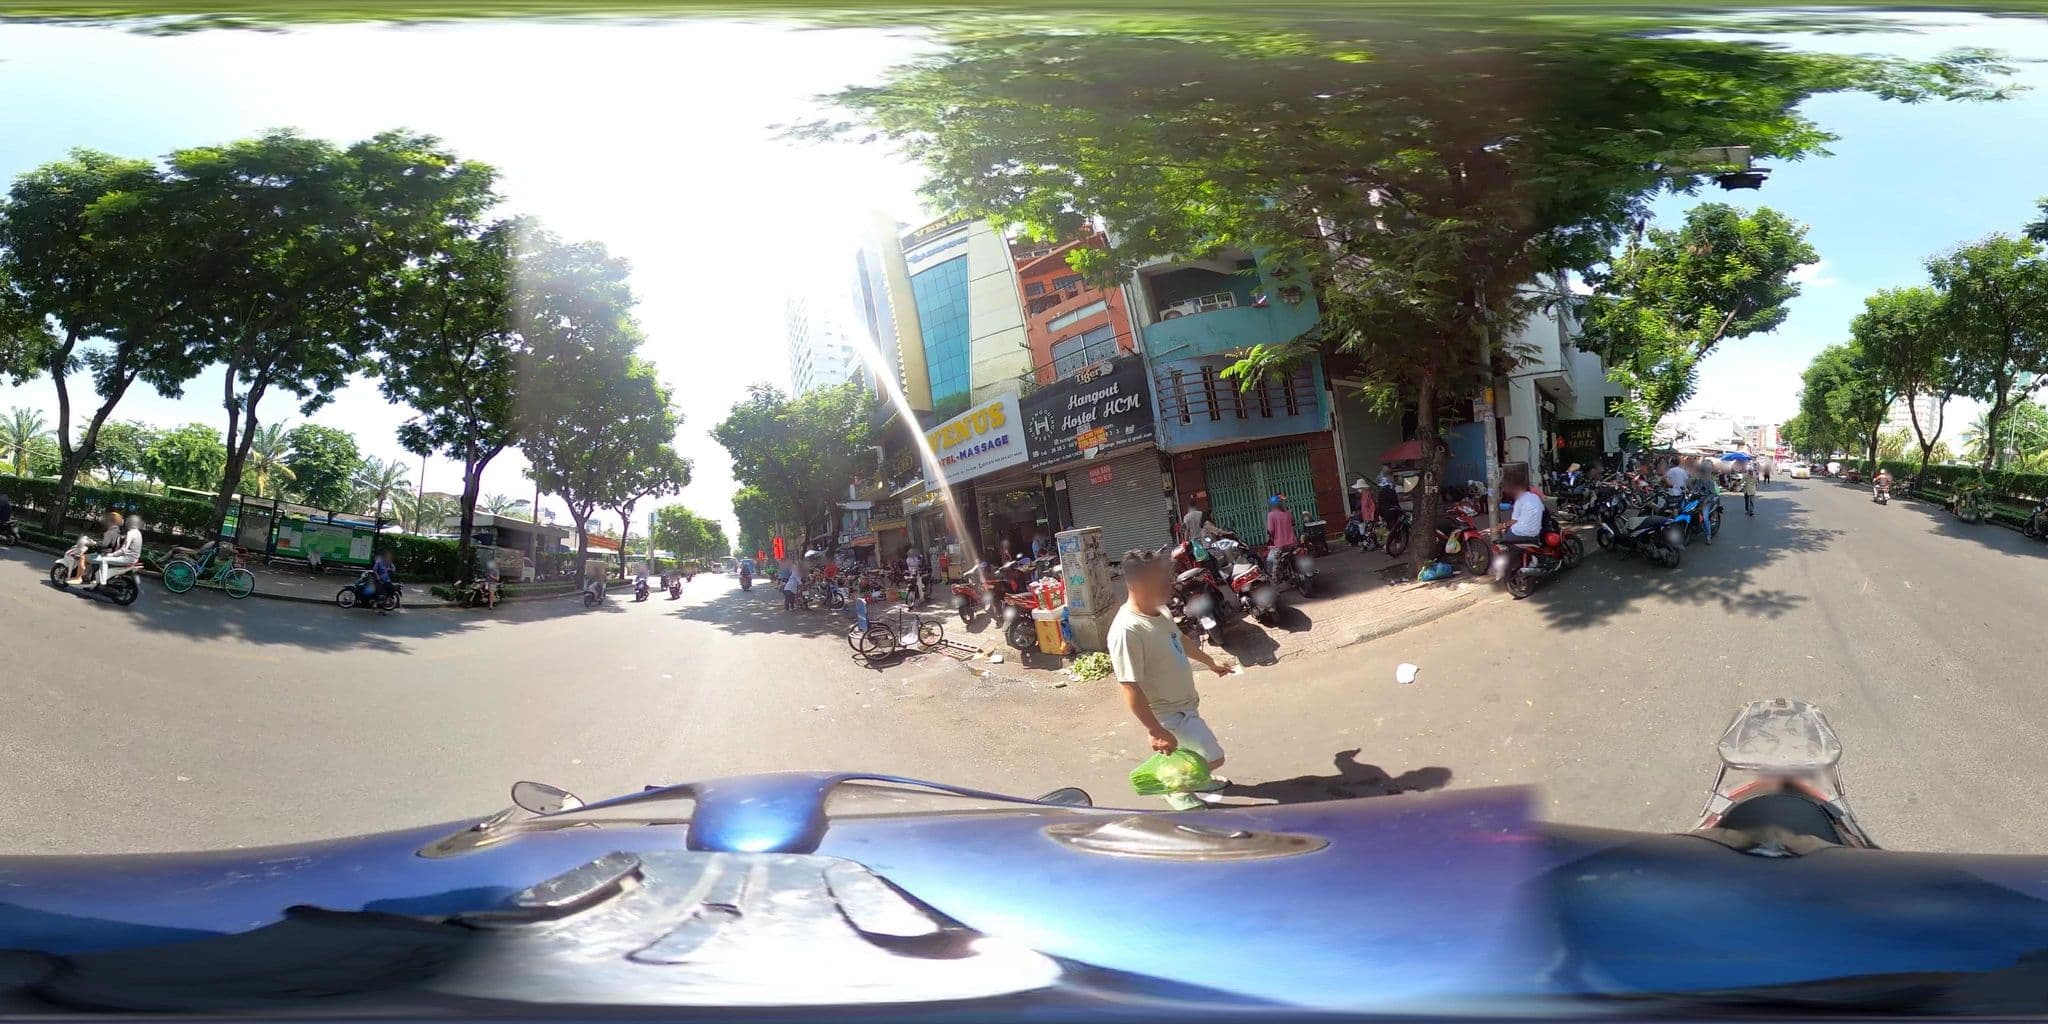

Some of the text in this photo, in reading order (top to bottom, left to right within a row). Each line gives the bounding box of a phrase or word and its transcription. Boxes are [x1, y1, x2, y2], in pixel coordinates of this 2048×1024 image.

[1075, 369, 1101, 384] Tiger
[1067, 382, 1120, 410] Hangout
[1061, 393, 1141, 431] Hostel HCM
[926, 401, 1007, 454] VENUS
[960, 434, 1009, 460] MASSAGE
